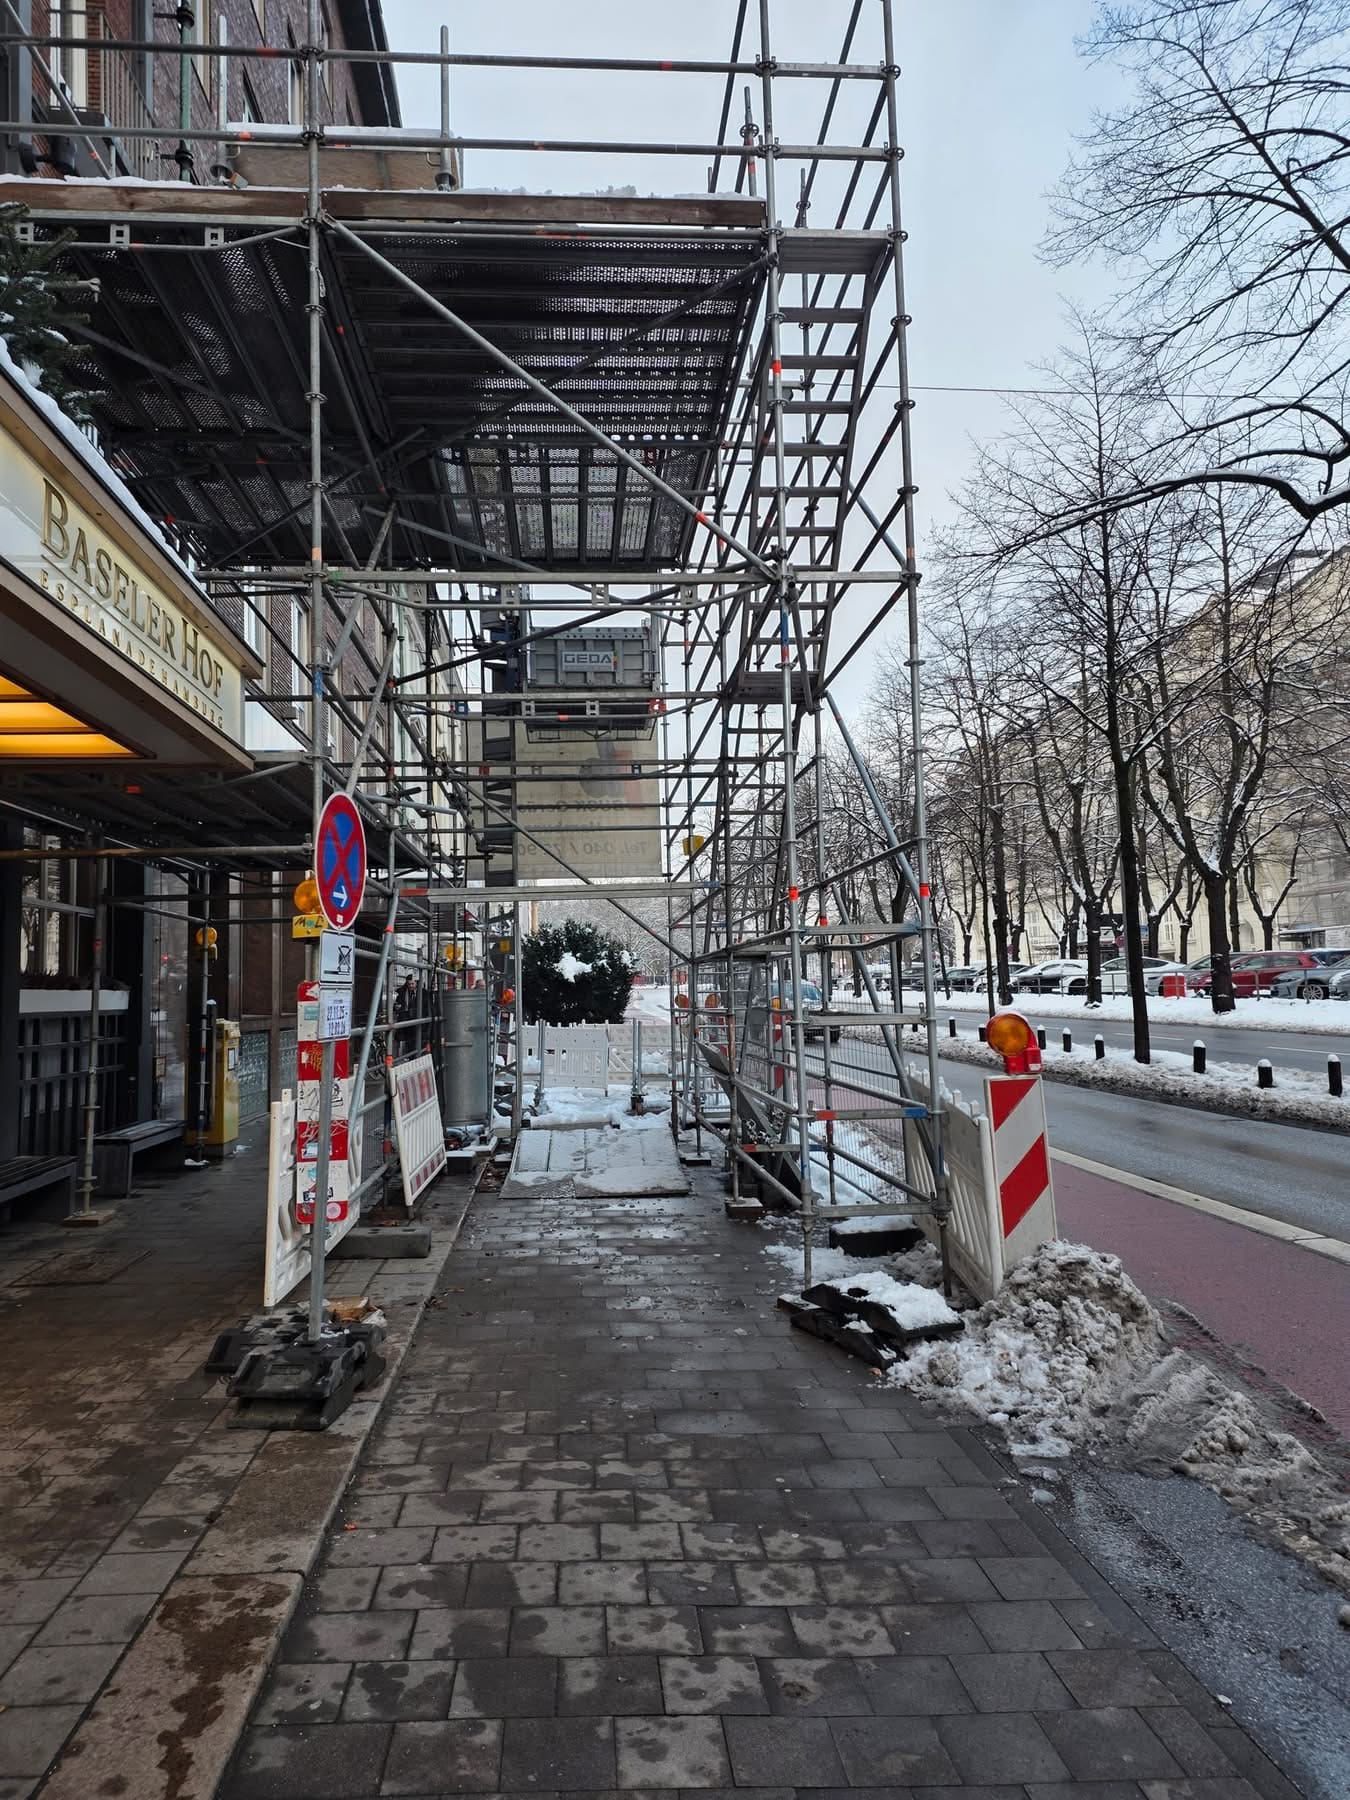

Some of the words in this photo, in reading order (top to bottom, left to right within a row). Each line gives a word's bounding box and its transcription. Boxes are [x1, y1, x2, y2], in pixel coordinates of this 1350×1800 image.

[41, 477, 177, 661] BASELER
[181, 617, 224, 698] HOF
[41, 569, 156, 675] ESPLANADE
[161, 667, 224, 730] HAMBURG
[564, 653, 612, 664] GEDA
